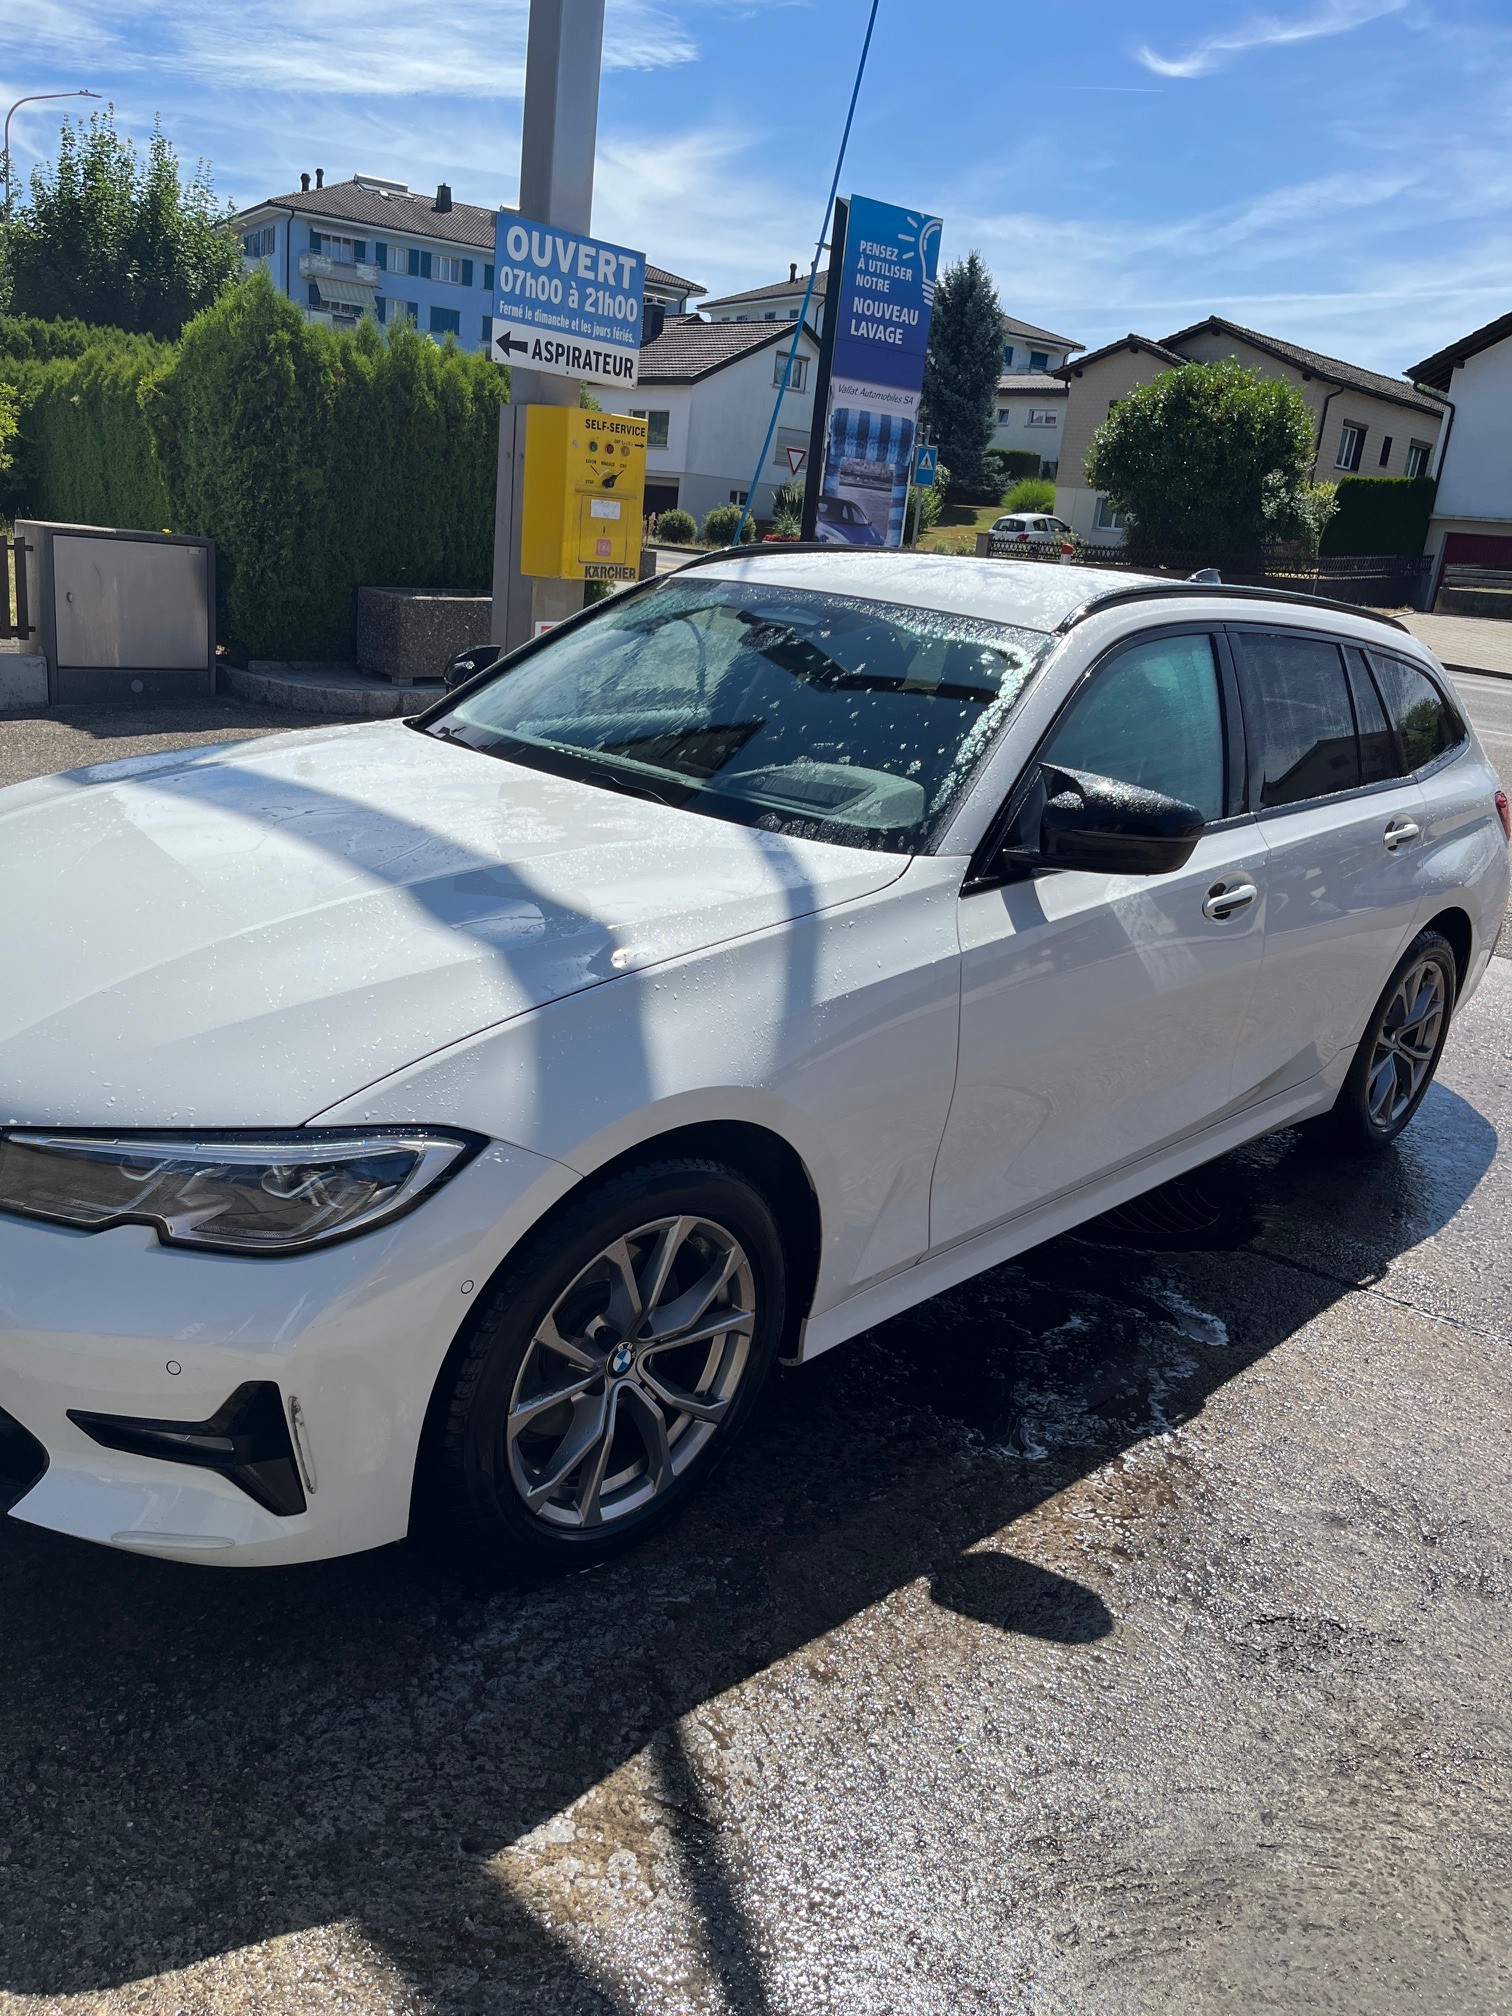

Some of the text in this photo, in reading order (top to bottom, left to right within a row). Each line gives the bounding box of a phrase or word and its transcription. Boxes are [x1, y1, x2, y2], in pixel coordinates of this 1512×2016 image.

[506, 225, 637, 290] OUVERT
[860, 240, 899, 262] PENSEZ
[857, 257, 913, 282] À UTILISER
[500, 265, 638, 323] 07h00 à 21h00
[856, 273, 890, 294] NOTRE
[500, 300, 635, 344] Fermé le dimanche et les jours fériés.
[853, 296, 919, 326] NOUVEAU
[850, 319, 904, 345] LAVAGE
[531, 338, 634, 379] ASPIRATEUR
[859, 387, 902, 404] Automobiles
[902, 395, 914, 405] SA
[585, 418, 646, 438] SELF-SERVICE
[584, 565, 636, 580] KÄRCHER
